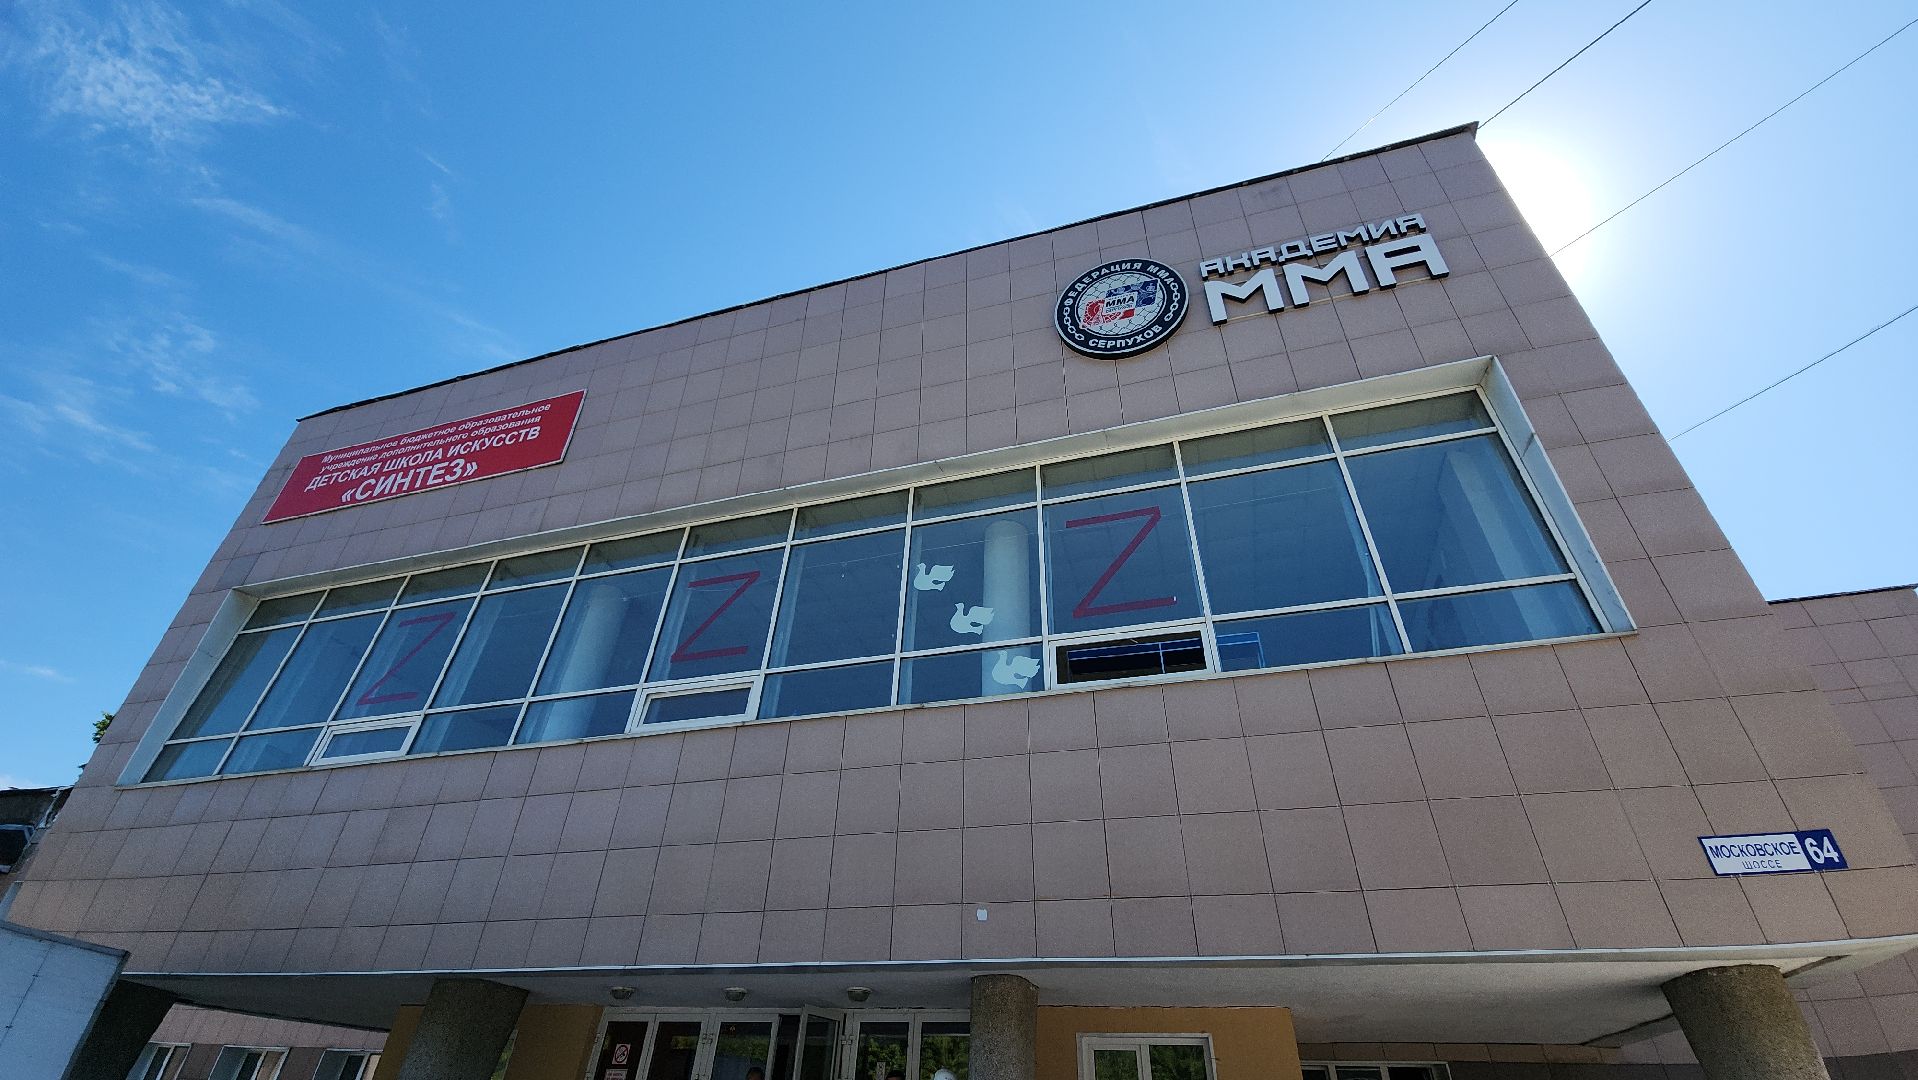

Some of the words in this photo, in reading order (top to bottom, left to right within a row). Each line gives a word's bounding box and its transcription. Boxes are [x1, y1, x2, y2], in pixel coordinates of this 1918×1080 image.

[1200, 213, 1426, 281] АКАДЕМИЯ
[1063, 262, 1142, 306] ФЕДЕРАЦИЯ
[1146, 264, 1176, 286] ММА
[1105, 296, 1134, 307] ММА
[1204, 233, 1449, 326] ММА
[1088, 324, 1162, 349] СЕРПУХОВ
[304, 462, 382, 492] ДЕТСКАЯ
[383, 448, 442, 472] ШКОЛА
[447, 425, 541, 457] ИСКУССТВ
[319, 453, 379, 474] учреждение
[379, 431, 468, 460] дополнительного
[471, 415, 541, 438] образования
[321, 440, 398, 463] Муниципальное
[400, 425, 456, 446] бюджетное
[458, 403, 551, 431] образовательное
[341, 457, 478, 502] «СИНТЕЗ»
[1066, 505, 1177, 619] Z
[670, 570, 761, 663] Z
[356, 611, 457, 706] Z
[1708, 841, 1801, 859] МОСКОВСКОЕ
[1741, 859, 1783, 870] ШОССЕ
[1804, 836, 1840, 865] 64
